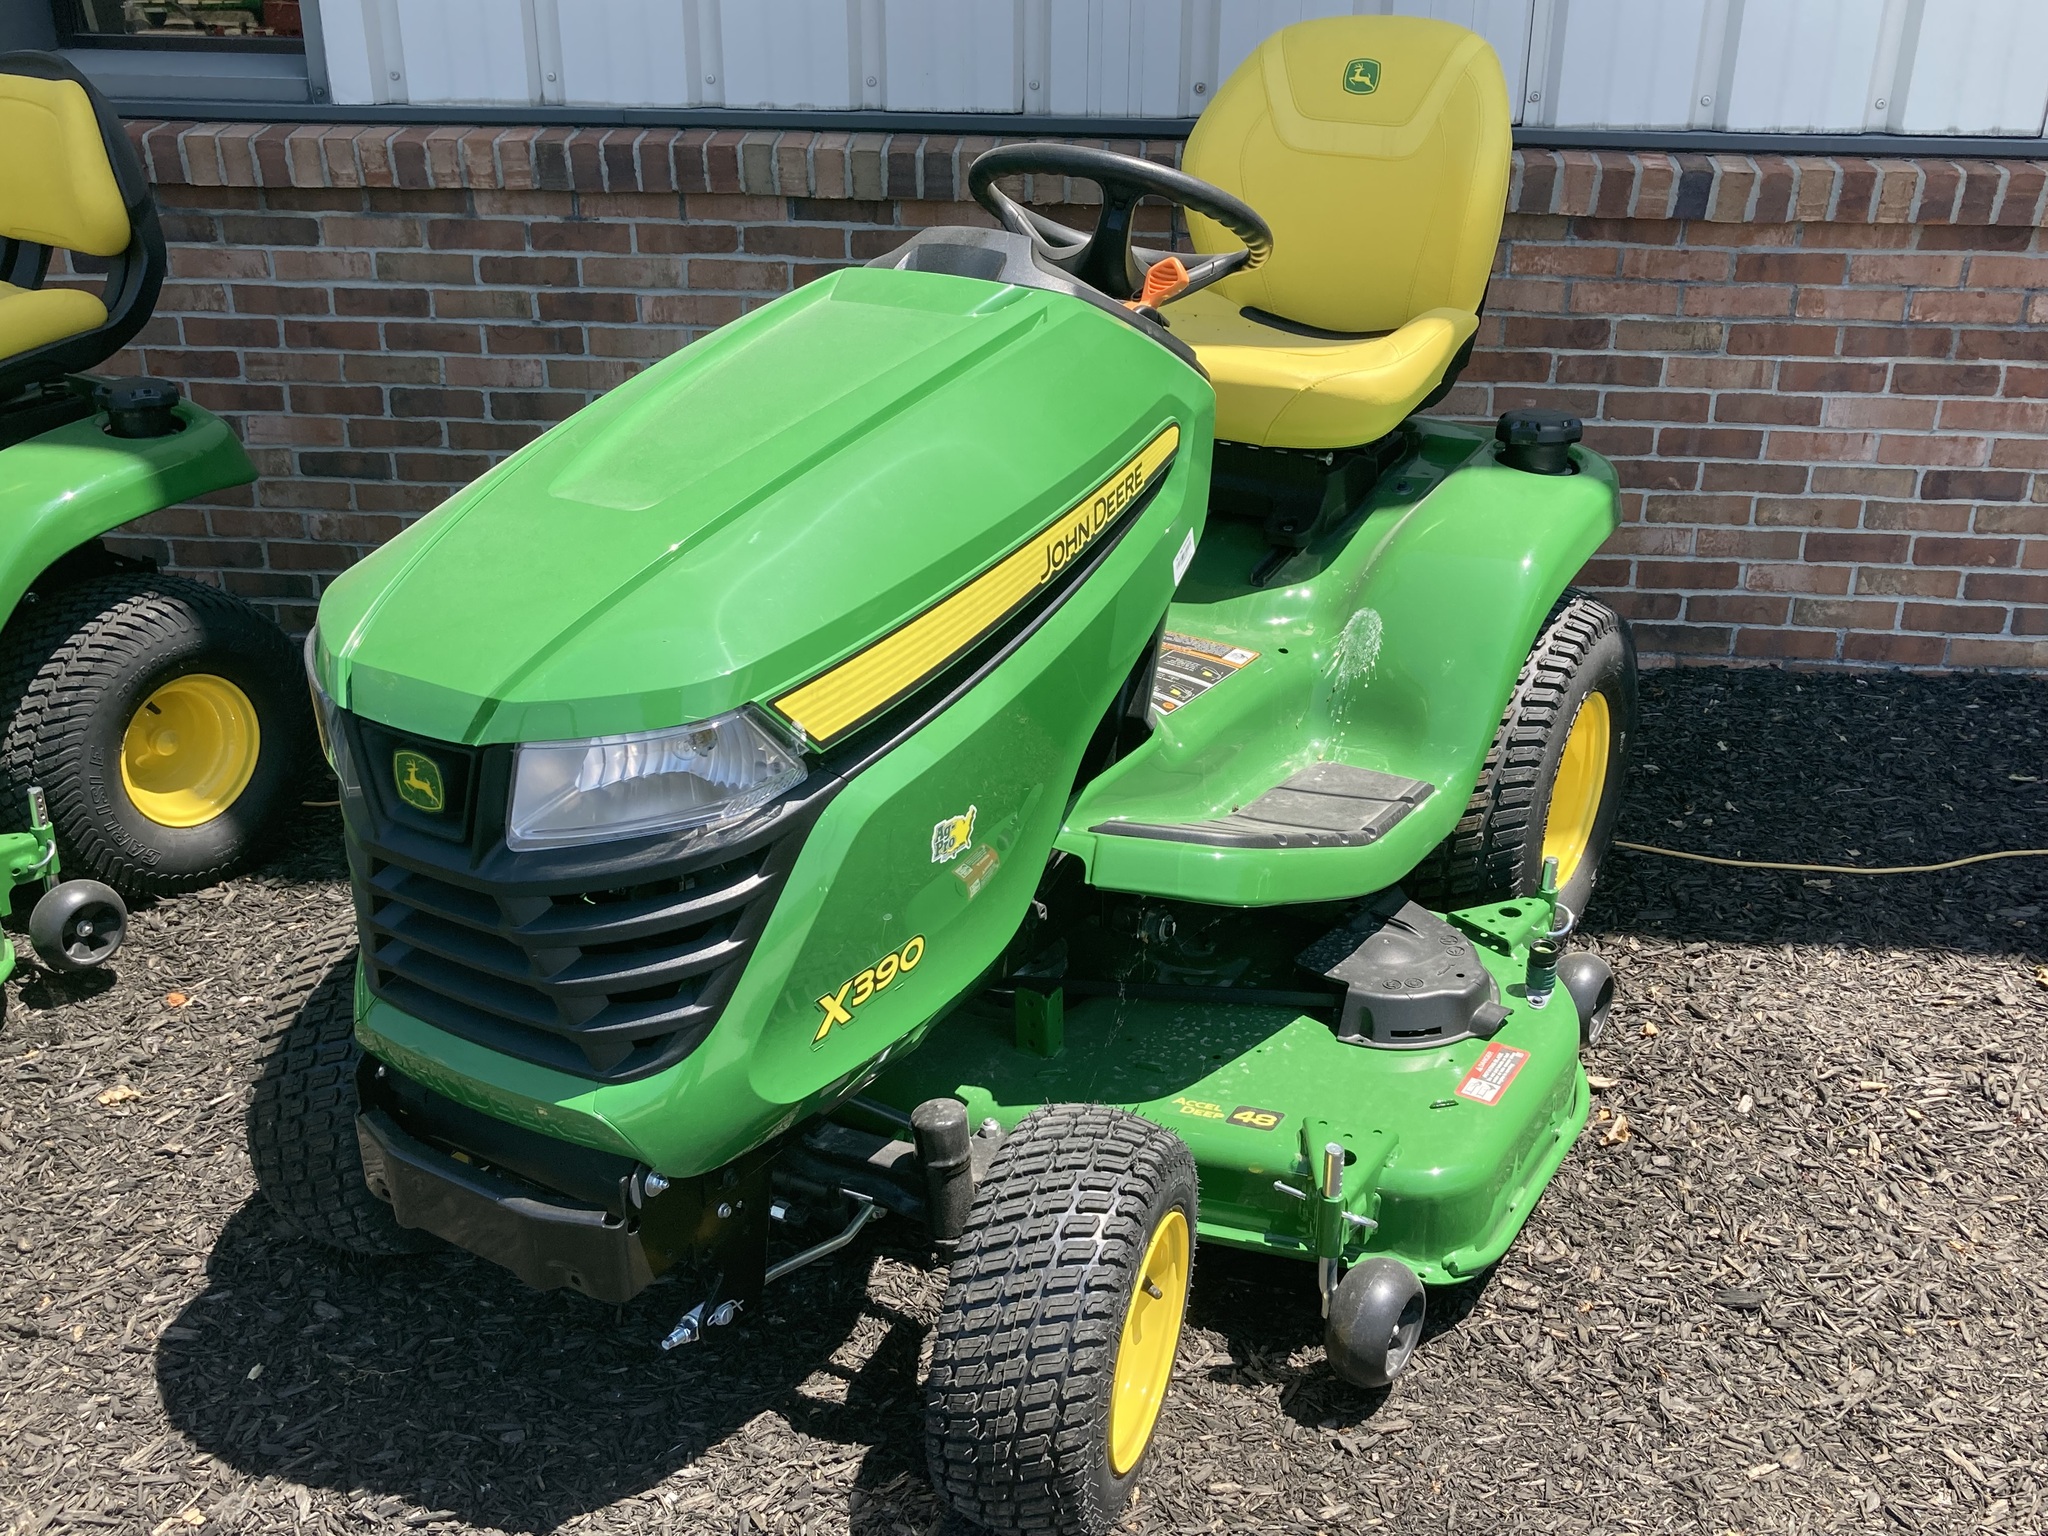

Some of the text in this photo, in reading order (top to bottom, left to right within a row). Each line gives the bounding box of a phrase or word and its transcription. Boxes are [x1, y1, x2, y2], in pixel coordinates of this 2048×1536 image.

[1040, 515, 1091, 584] JOHN
[1093, 462, 1145, 534] DEERE
[935, 836, 955, 857] Pro
[811, 933, 926, 1044] X390
[1171, 1096, 1223, 1112] ACCEL
[1179, 1105, 1226, 1119] DEEP
[1232, 1110, 1278, 1127] 48
